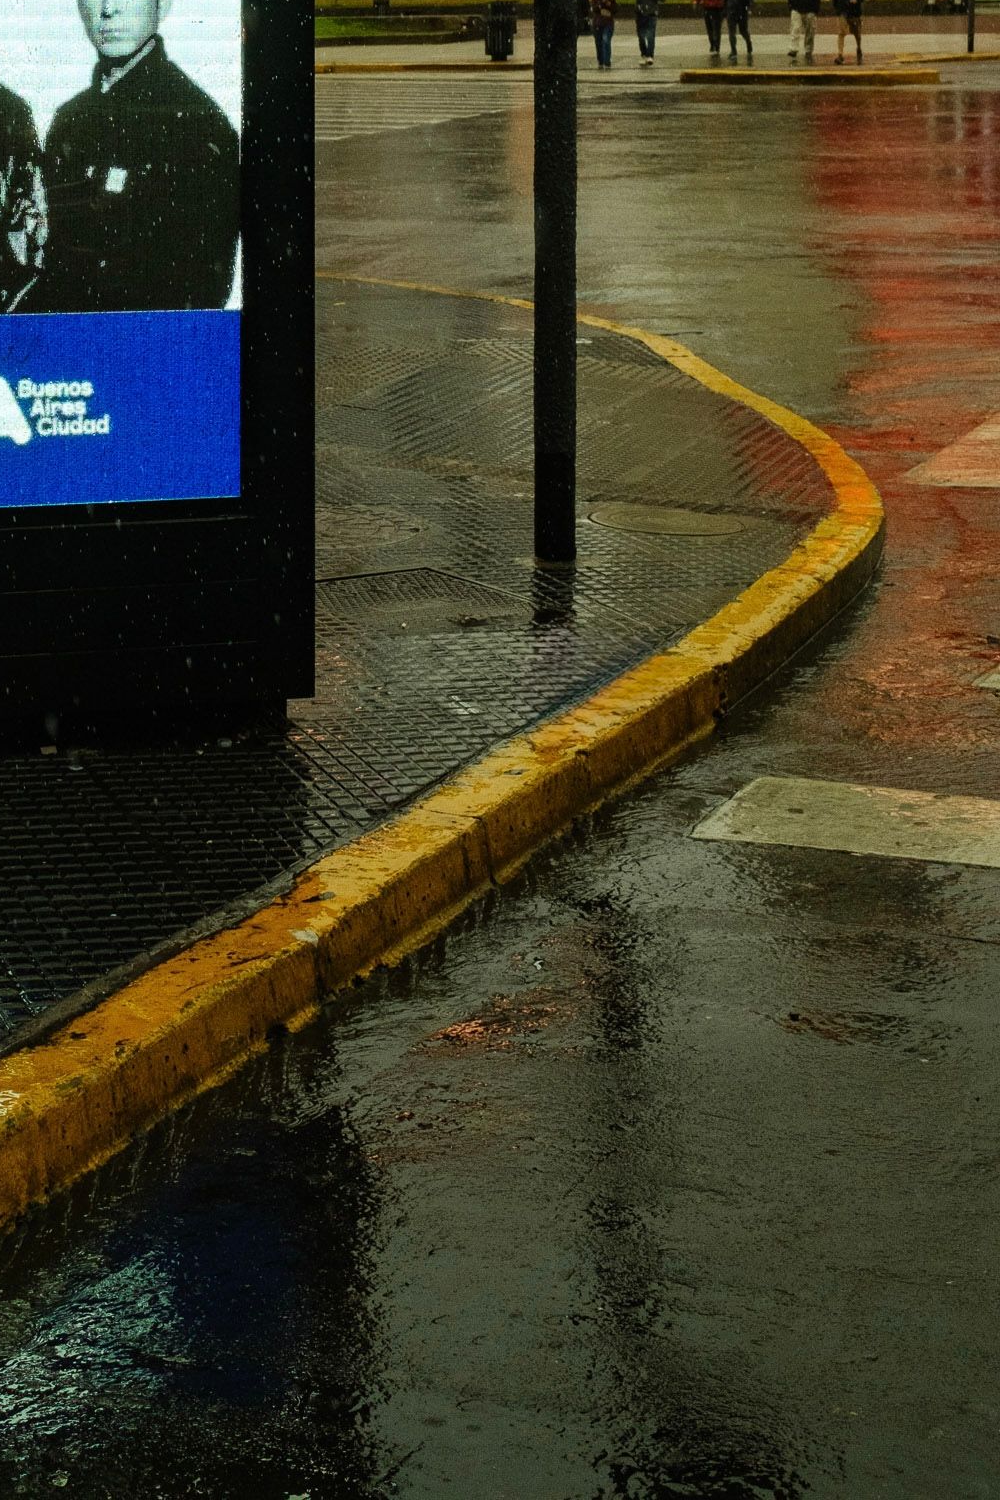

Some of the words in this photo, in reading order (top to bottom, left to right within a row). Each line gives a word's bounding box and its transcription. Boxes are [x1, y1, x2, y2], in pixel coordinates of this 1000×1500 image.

[17, 378, 94, 399] Buenos
[30, 399, 88, 418] Aires
[36, 413, 111, 437] Ciudad
